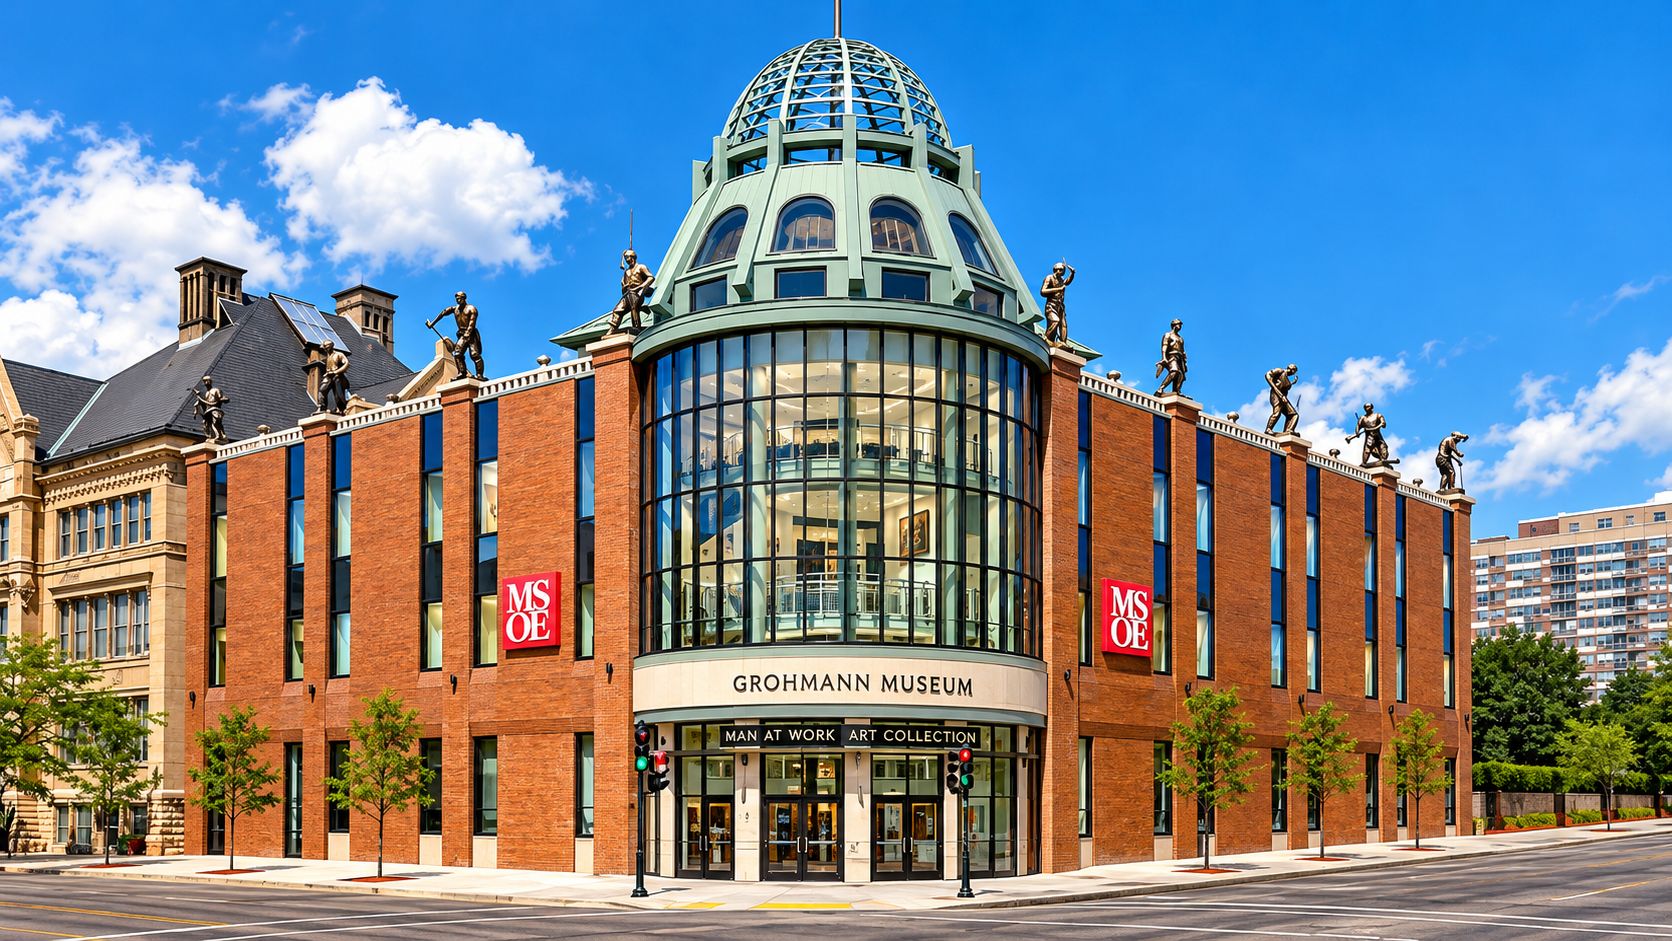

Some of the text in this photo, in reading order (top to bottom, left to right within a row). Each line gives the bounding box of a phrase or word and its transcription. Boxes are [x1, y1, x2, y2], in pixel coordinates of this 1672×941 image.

[733, 673, 973, 697] GROHMANN MUSEUM
[725, 729, 976, 744] MAN AT WORK ART COLLECTION
